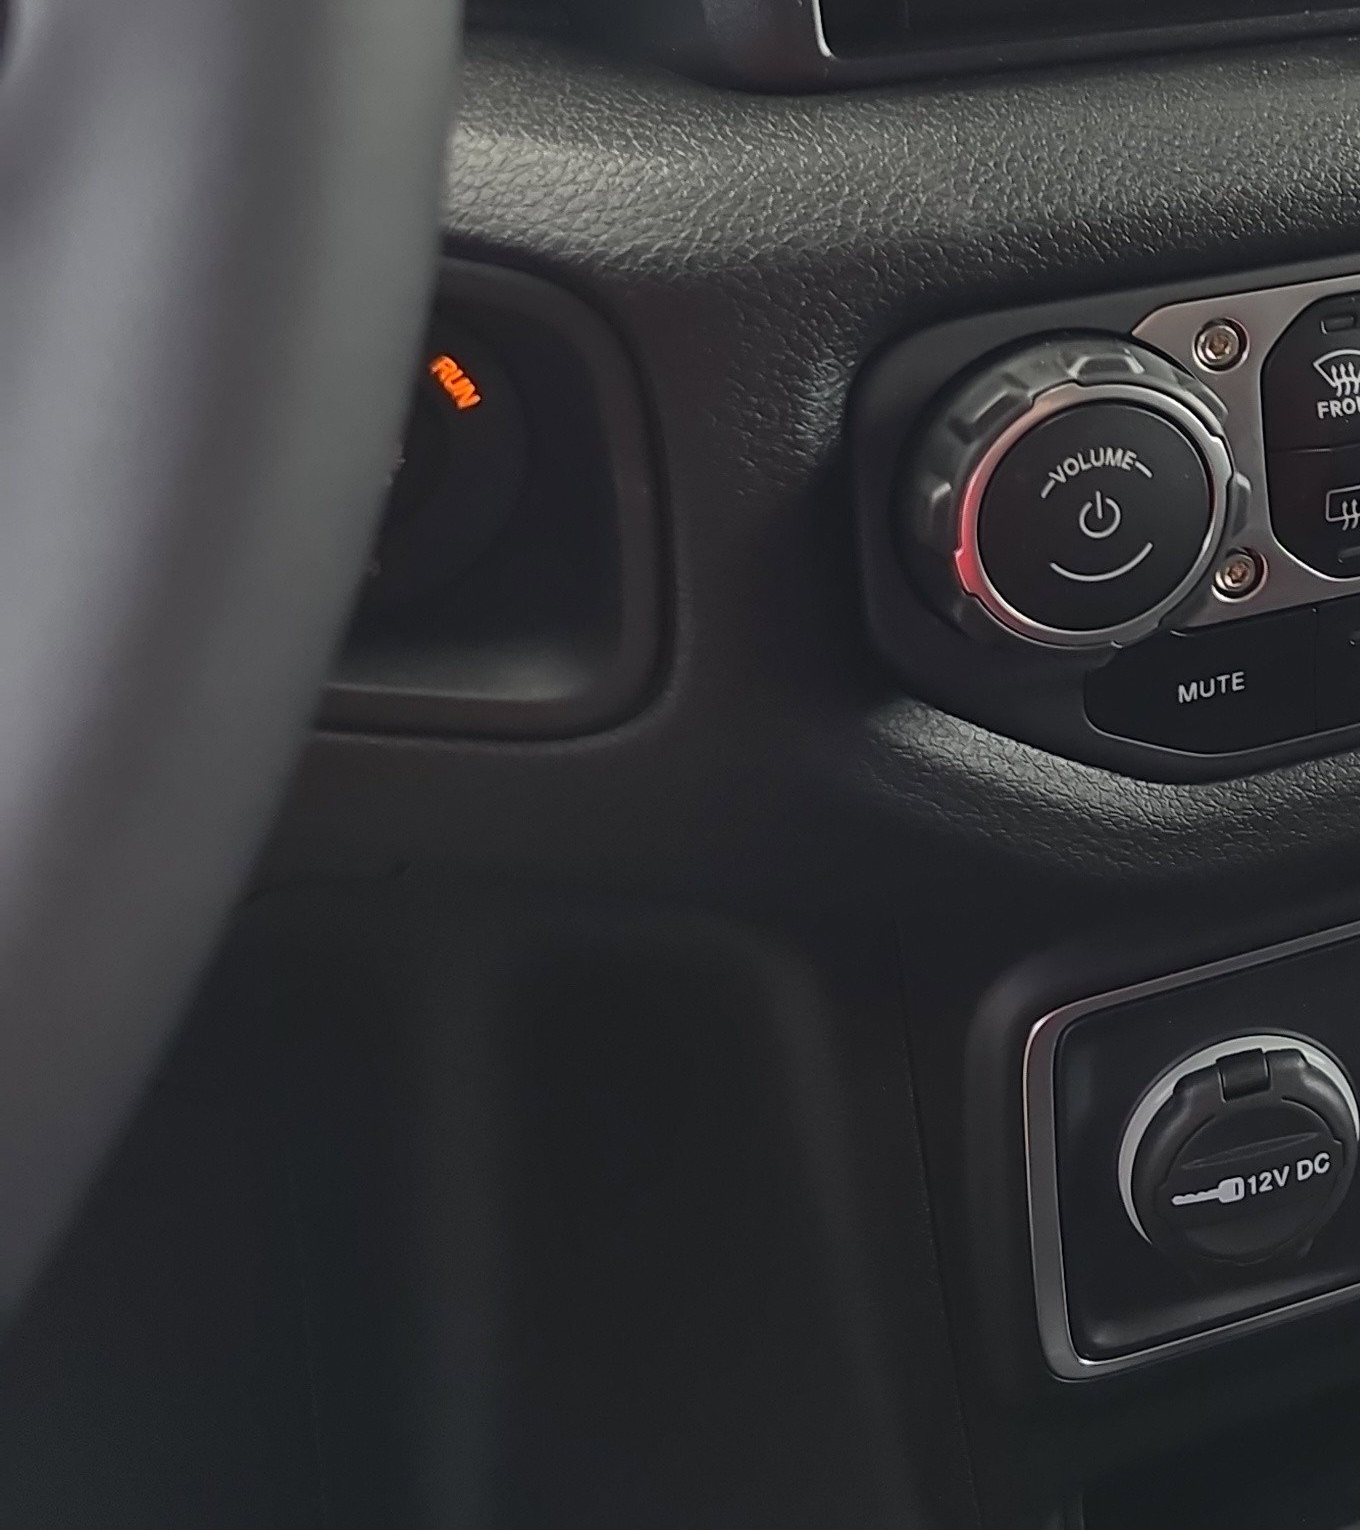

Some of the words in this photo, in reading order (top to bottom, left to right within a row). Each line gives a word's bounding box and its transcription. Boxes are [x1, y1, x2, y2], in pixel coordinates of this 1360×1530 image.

[431, 355, 481, 409] RUN
[1049, 447, 1138, 485] VOLUME
[1177, 671, 1246, 704] MUTE
[1247, 1165, 1290, 1195] 12V
[1296, 1152, 1331, 1181] DC
